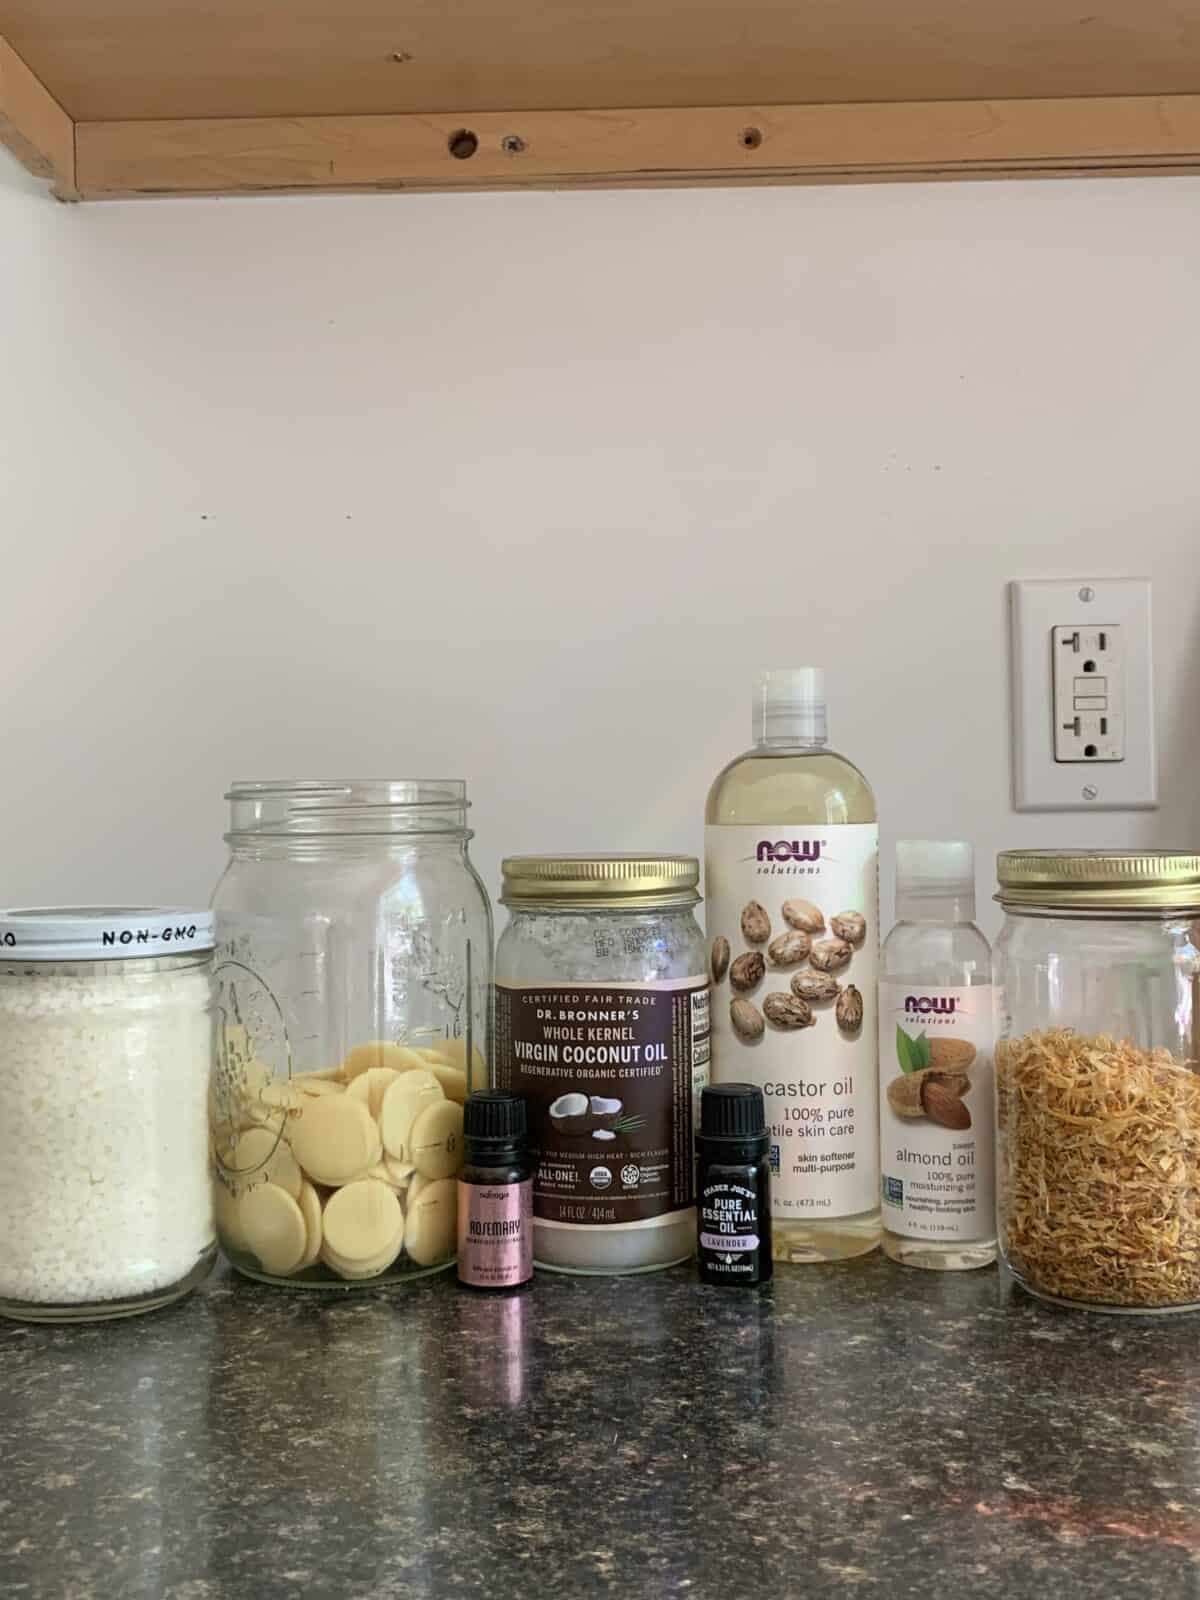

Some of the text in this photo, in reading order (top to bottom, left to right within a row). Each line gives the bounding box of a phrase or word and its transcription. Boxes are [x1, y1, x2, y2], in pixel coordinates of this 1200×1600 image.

[102, 925, 197, 945] NON-GMO
[522, 995, 657, 1006] CERTIFIED FAIR TRADE
[536, 1009, 640, 1021] DR. BRONNER'S
[543, 1026, 636, 1041] WHOLE KERNEL
[514, 1040, 668, 1064] VIRGIN COCONUT OIL
[520, 1063, 574, 1078] REGENERATIVE
[576, 1067, 617, 1079] ORGANIC
[763, 1076, 853, 1097] castor oil
[784, 1107, 855, 1122] 100% pure
[798, 1124, 825, 1137] skin
[829, 1124, 855, 1137] care
[798, 1151, 855, 1163] skin softener
[896, 1147, 975, 1166] almond oil
[793, 1161, 856, 1174] multi-purpose
[714, 1199, 742, 1210] PURE
[703, 1208, 758, 1222] ESSENTIAL
[470, 1220, 520, 1236] ROSEMARY
[720, 1222, 737, 1234] OIL
